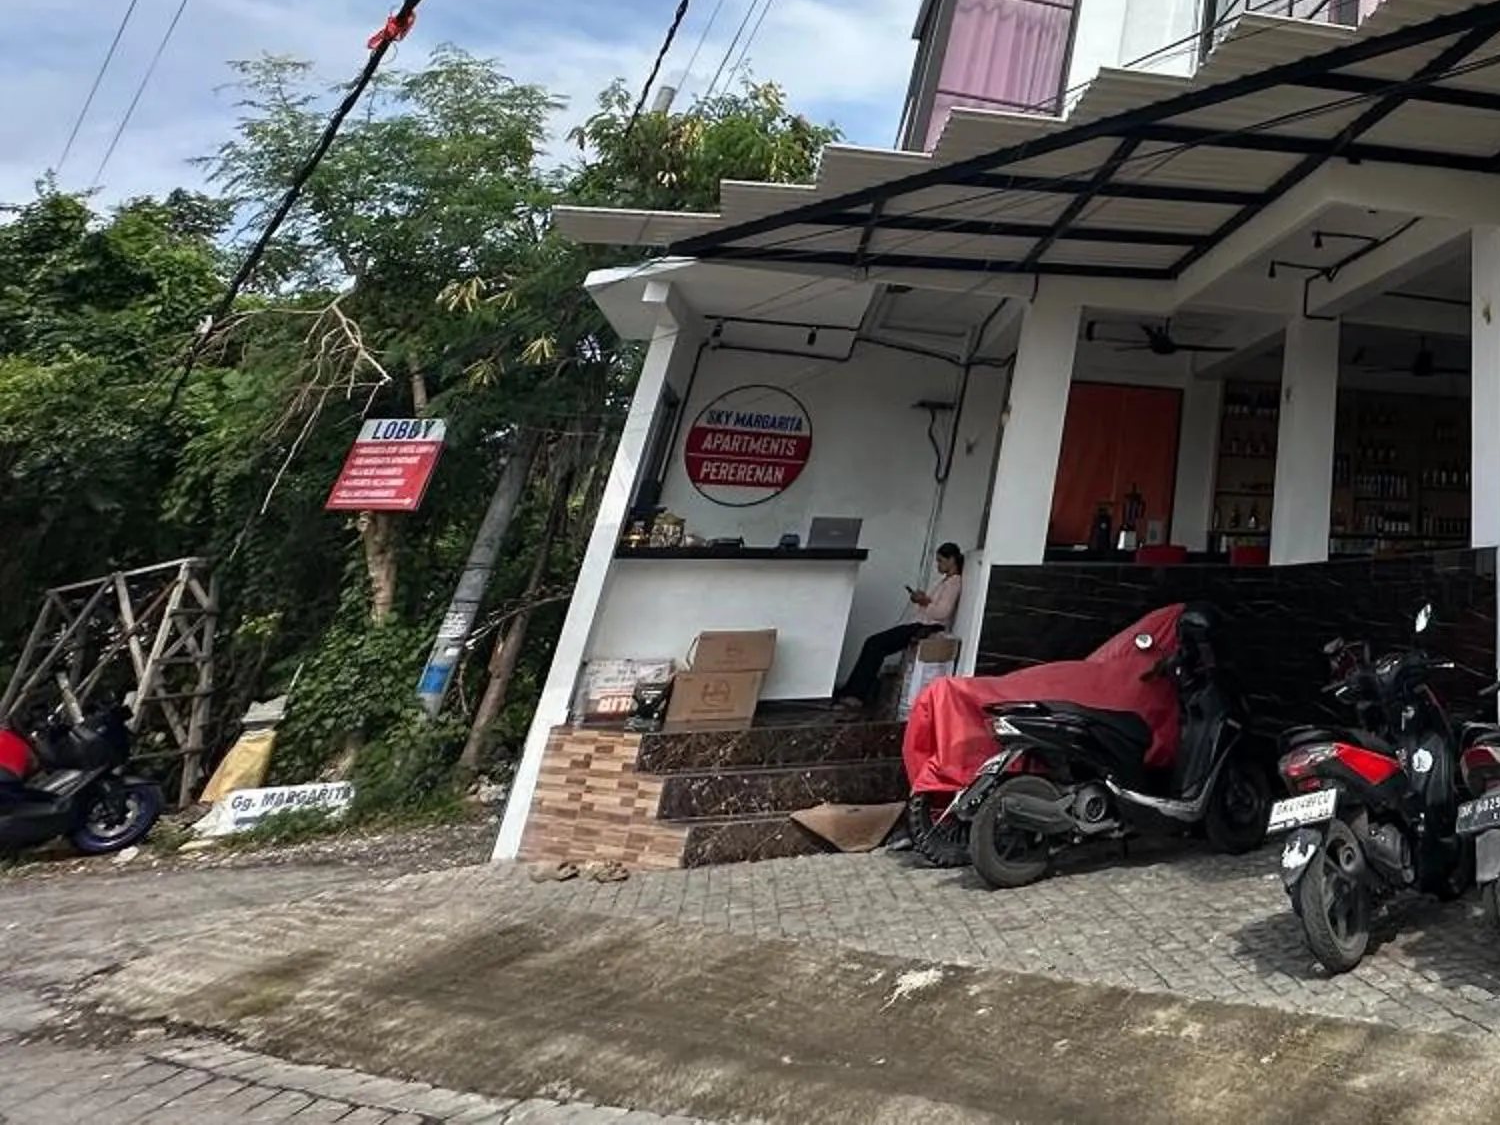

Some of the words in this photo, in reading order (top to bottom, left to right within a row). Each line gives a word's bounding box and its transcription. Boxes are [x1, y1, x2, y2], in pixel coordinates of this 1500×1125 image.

[371, 420, 436, 440] LOBBY
[707, 410, 734, 425] SKY
[734, 412, 803, 432] MARGARITA
[701, 432, 797, 456] APARTMENTS
[700, 461, 785, 484] PERERENAN
[231, 795, 257, 812] Gg.
